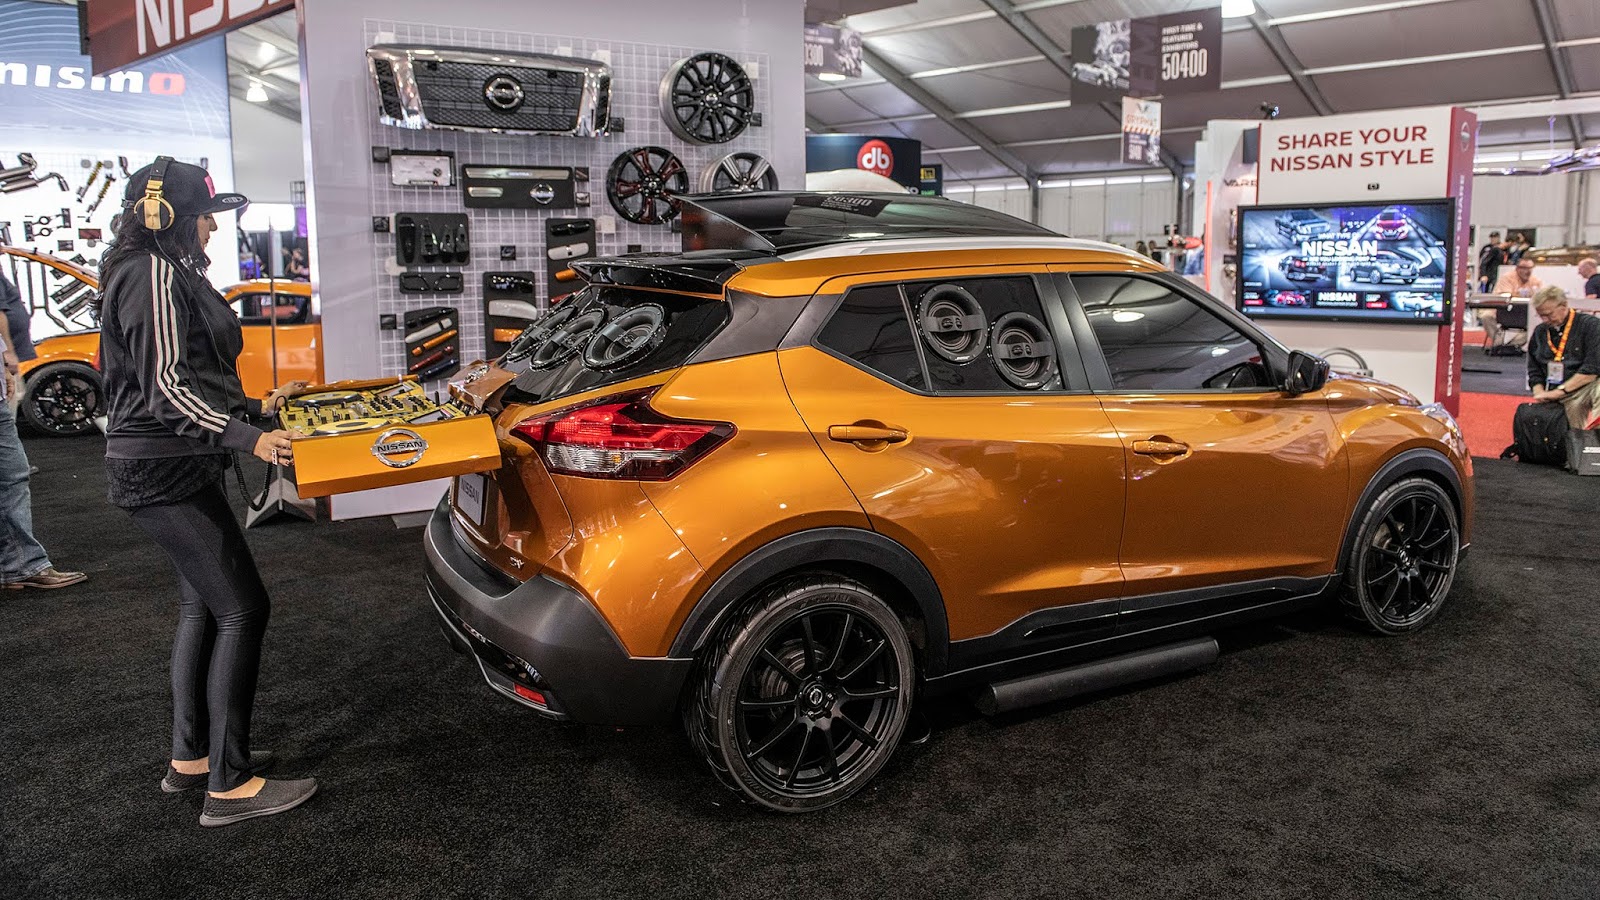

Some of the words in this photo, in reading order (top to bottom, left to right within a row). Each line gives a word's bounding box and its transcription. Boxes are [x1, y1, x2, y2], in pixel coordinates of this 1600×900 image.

[1161, 32, 1194, 44] FEATURED
[1161, 40, 1199, 54] EXHIBITORS
[1161, 48, 1208, 81] 50400
[1278, 131, 1353, 150] SHARE
[1359, 125, 1428, 144] YOUR
[862, 147, 890, 169] db
[1271, 153, 1353, 172] NISSAN
[1360, 148, 1434, 167] STYLE
[1301, 240, 1378, 257] NISSAN
[1318, 292, 1357, 302] NISSAN
[1446, 321, 1456, 397] EXPLORE
[1457, 175, 1465, 232] SHARE
[377, 441, 423, 453] NISSAN
[461, 478, 480, 504] NISSAN
